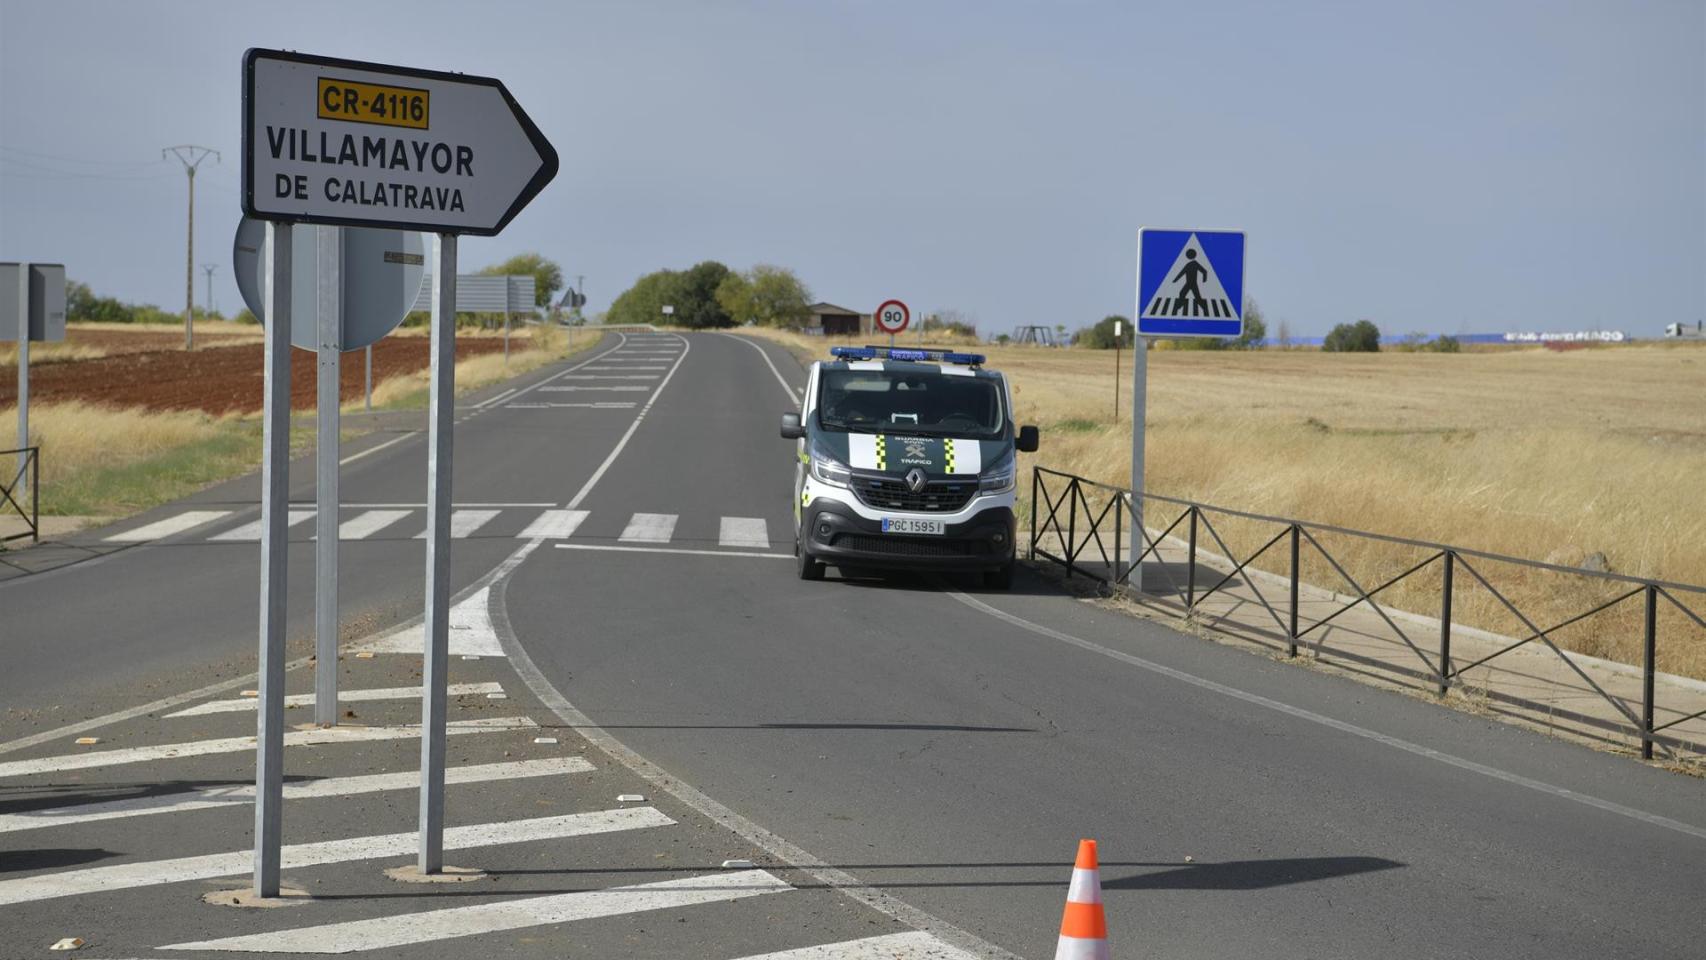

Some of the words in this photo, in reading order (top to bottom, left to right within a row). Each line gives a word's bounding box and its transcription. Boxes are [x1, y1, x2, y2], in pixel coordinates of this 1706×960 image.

[323, 85, 424, 122] CR-4116
[266, 125, 474, 177] VILLAMAYOR
[275, 173, 308, 200] DE
[324, 177, 465, 213] CALATRAVA
[884, 311, 902, 322] 90
